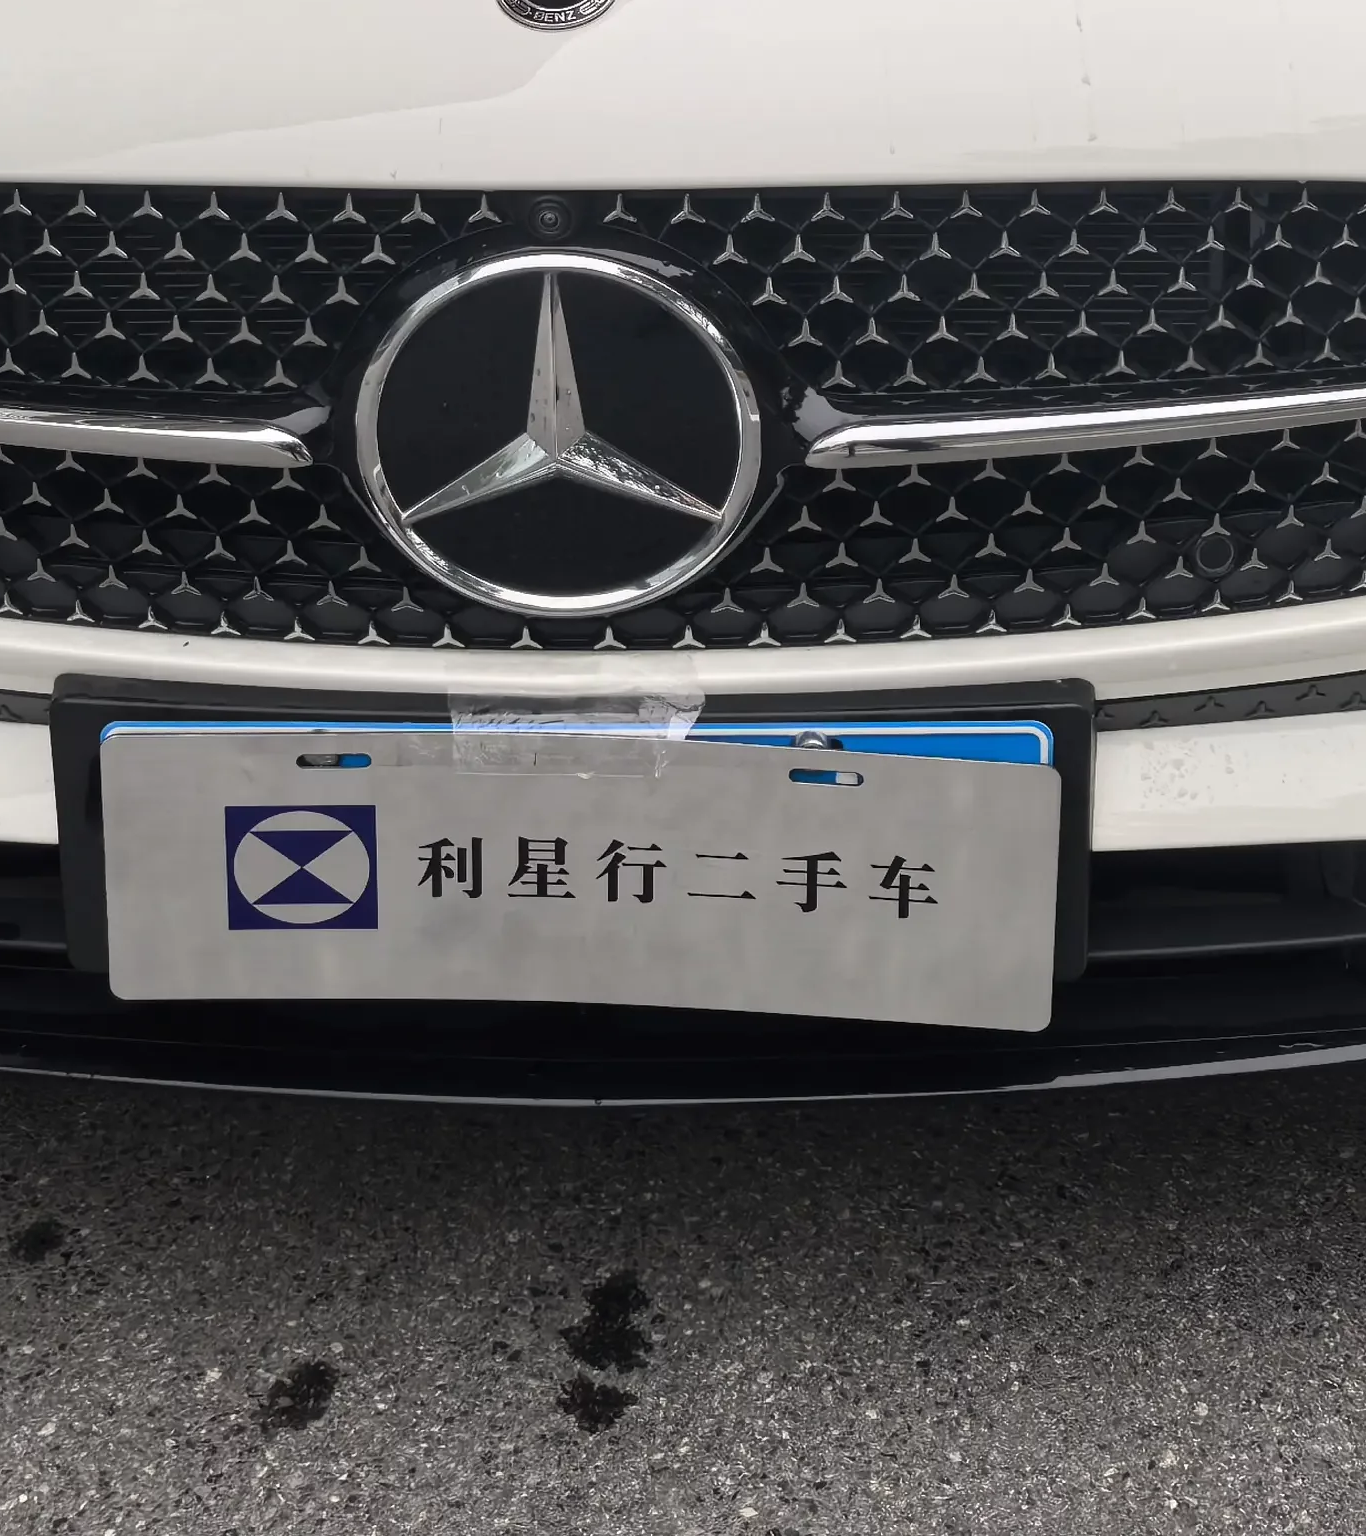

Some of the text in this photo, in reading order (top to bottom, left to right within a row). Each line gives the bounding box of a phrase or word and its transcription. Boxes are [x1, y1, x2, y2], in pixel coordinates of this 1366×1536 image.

[533, 10, 577, 23] BENZ
[416, 836, 939, 919] 利星行二手车
